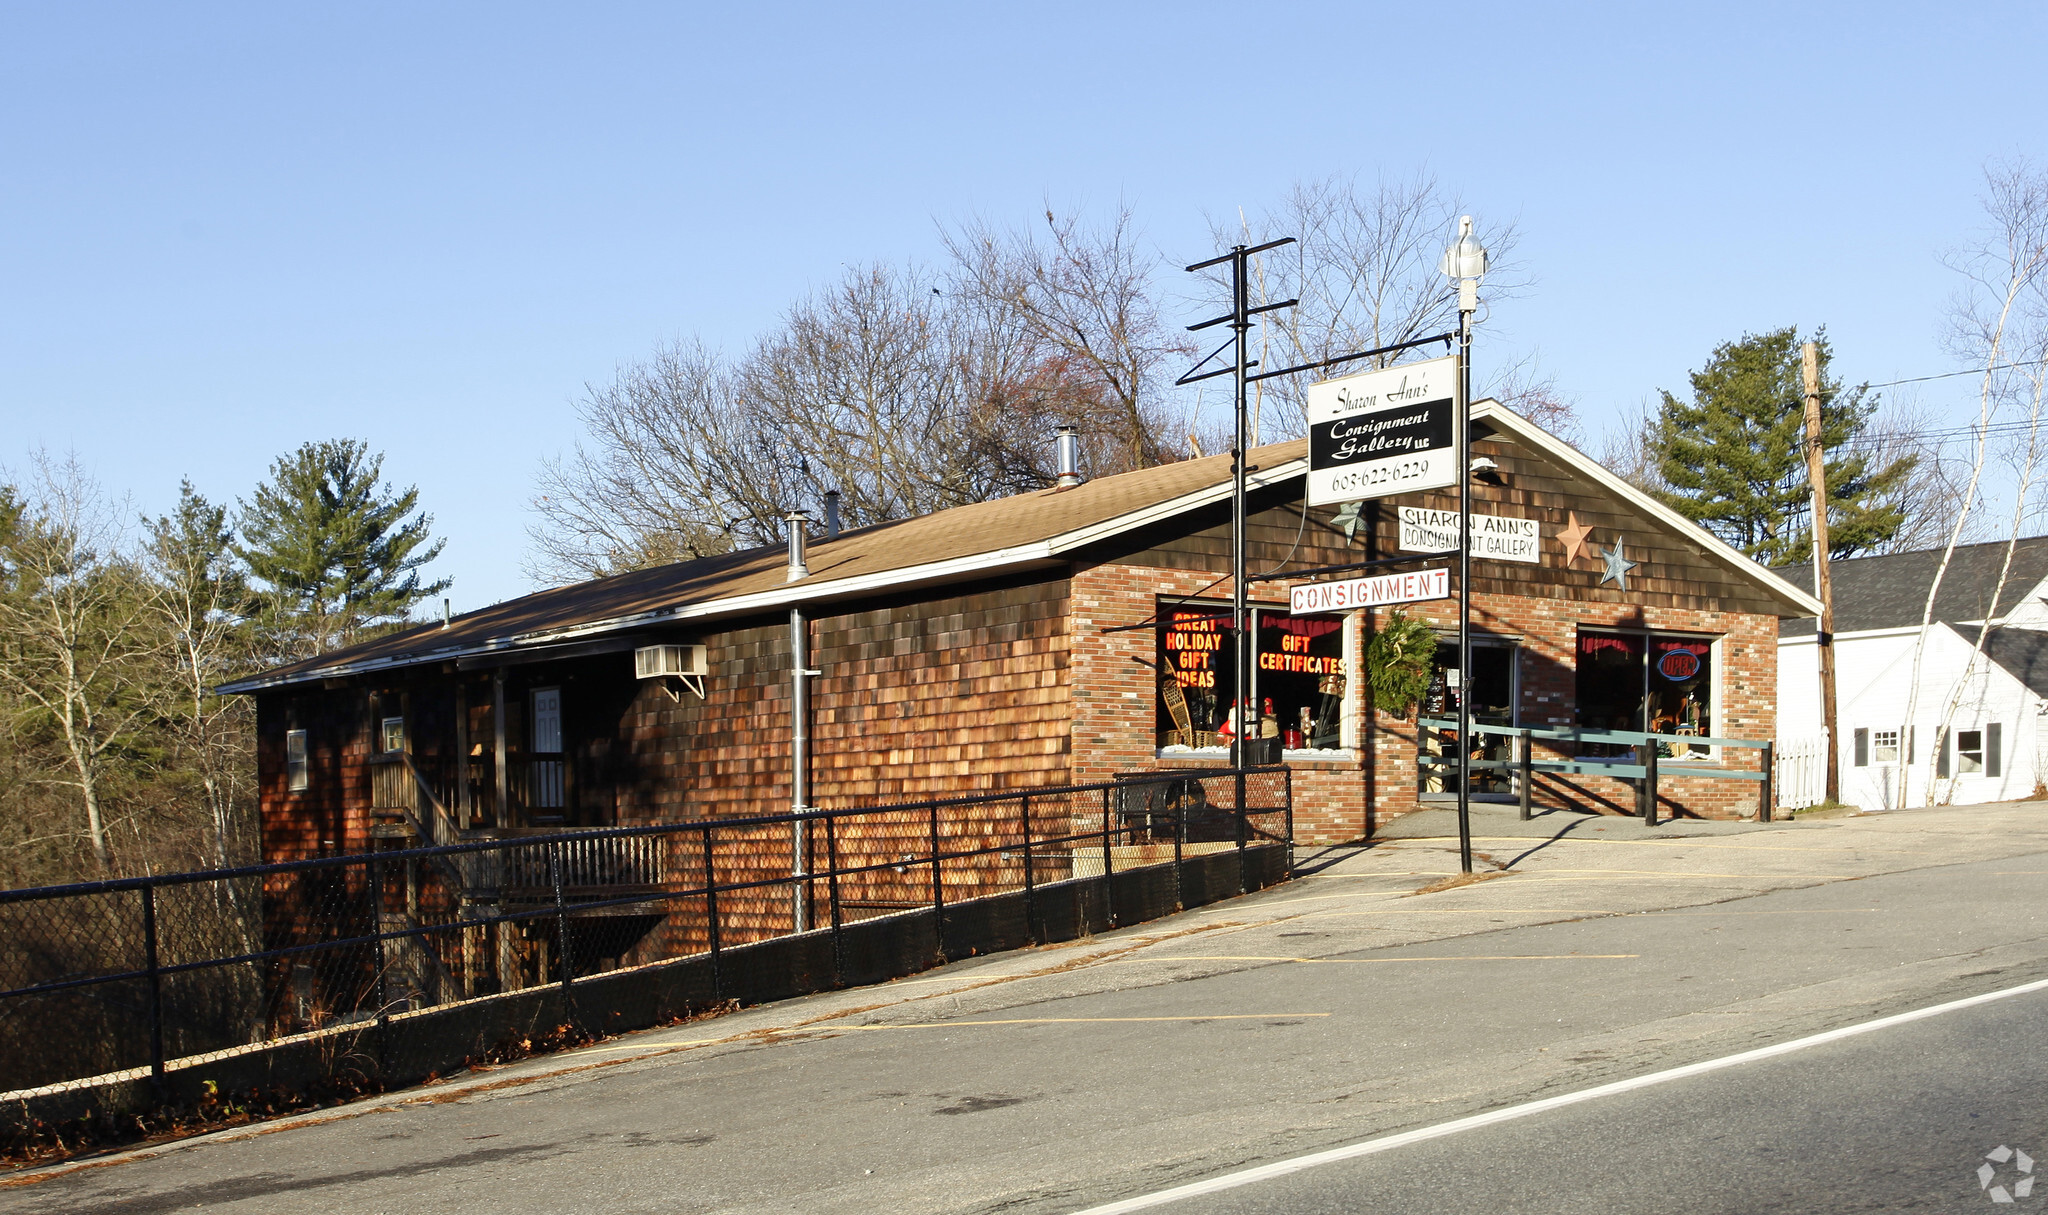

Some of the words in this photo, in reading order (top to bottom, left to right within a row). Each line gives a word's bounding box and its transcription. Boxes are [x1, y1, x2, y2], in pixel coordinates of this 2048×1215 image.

[1332, 387, 1376, 414] Sharon
[1386, 372, 1428, 402] Ann's
[1331, 410, 1429, 439] Consignment
[1331, 436, 1413, 460] Gallery
[1414, 438, 1430, 450] LLC
[1332, 460, 1429, 491] 603-622-6229
[1484, 517, 1534, 538] ANN'S
[1404, 528, 1483, 552] CONSIGNMNT
[1486, 536, 1534, 557] GALLERY
[1293, 572, 1445, 610] CONSIGNMENT
[1174, 612, 1216, 631] GREAT
[1166, 632, 1222, 651] HOLIDAY
[1282, 634, 1311, 653] GIFT
[1179, 651, 1209, 669] GIFT
[1260, 652, 1346, 675] CERTIFICATES
[1663, 655, 1697, 676] OPEN
[1176, 670, 1215, 688] IDEAS
